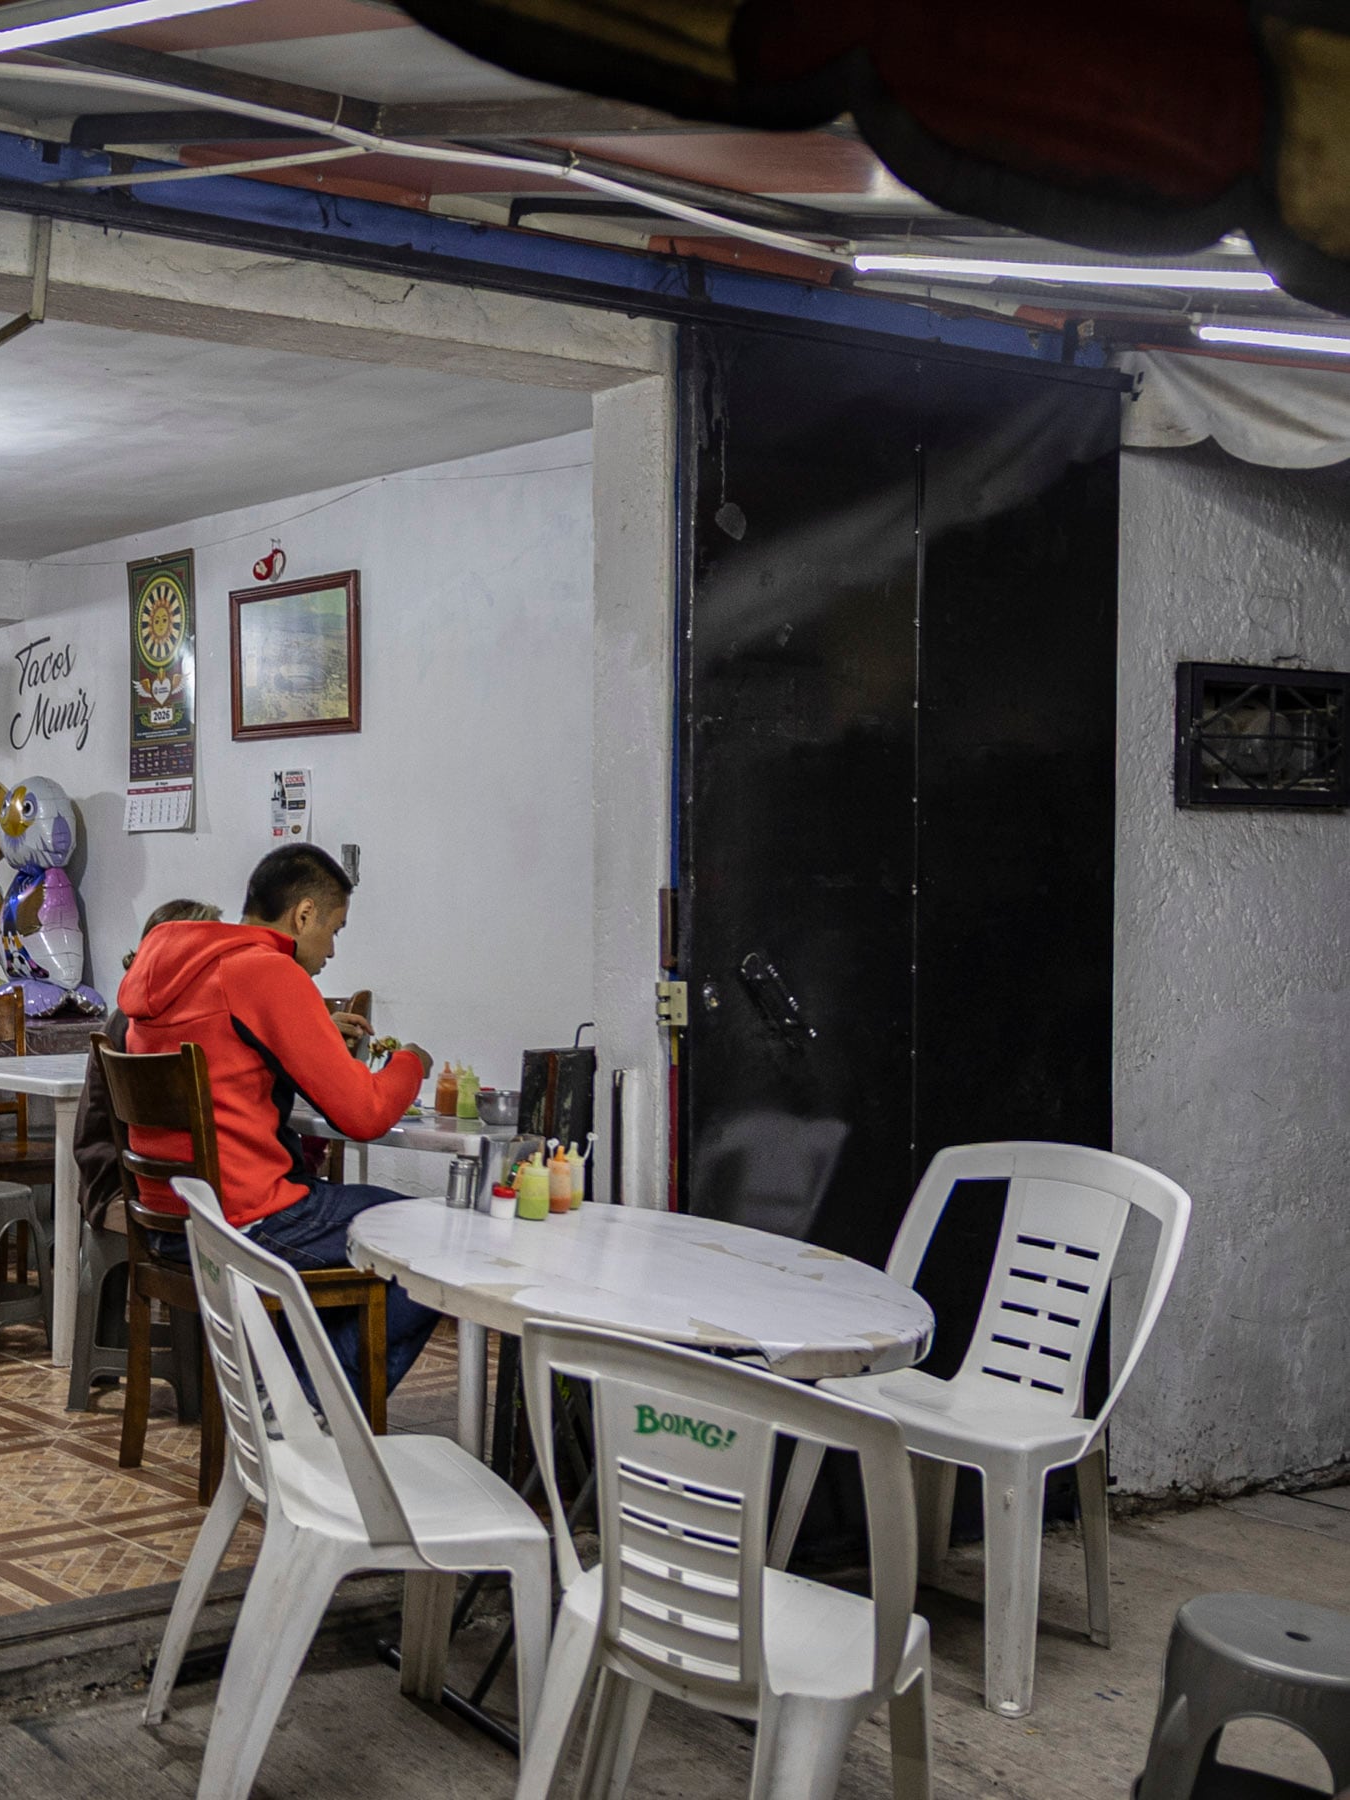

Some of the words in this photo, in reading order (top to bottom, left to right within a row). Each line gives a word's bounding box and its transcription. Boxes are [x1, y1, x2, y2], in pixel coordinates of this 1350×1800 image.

[15, 636, 77, 695] Tacos
[10, 688, 96, 751] Muniz
[153, 710, 171, 721] 2026
[633, 1403, 738, 1451] BOING!
